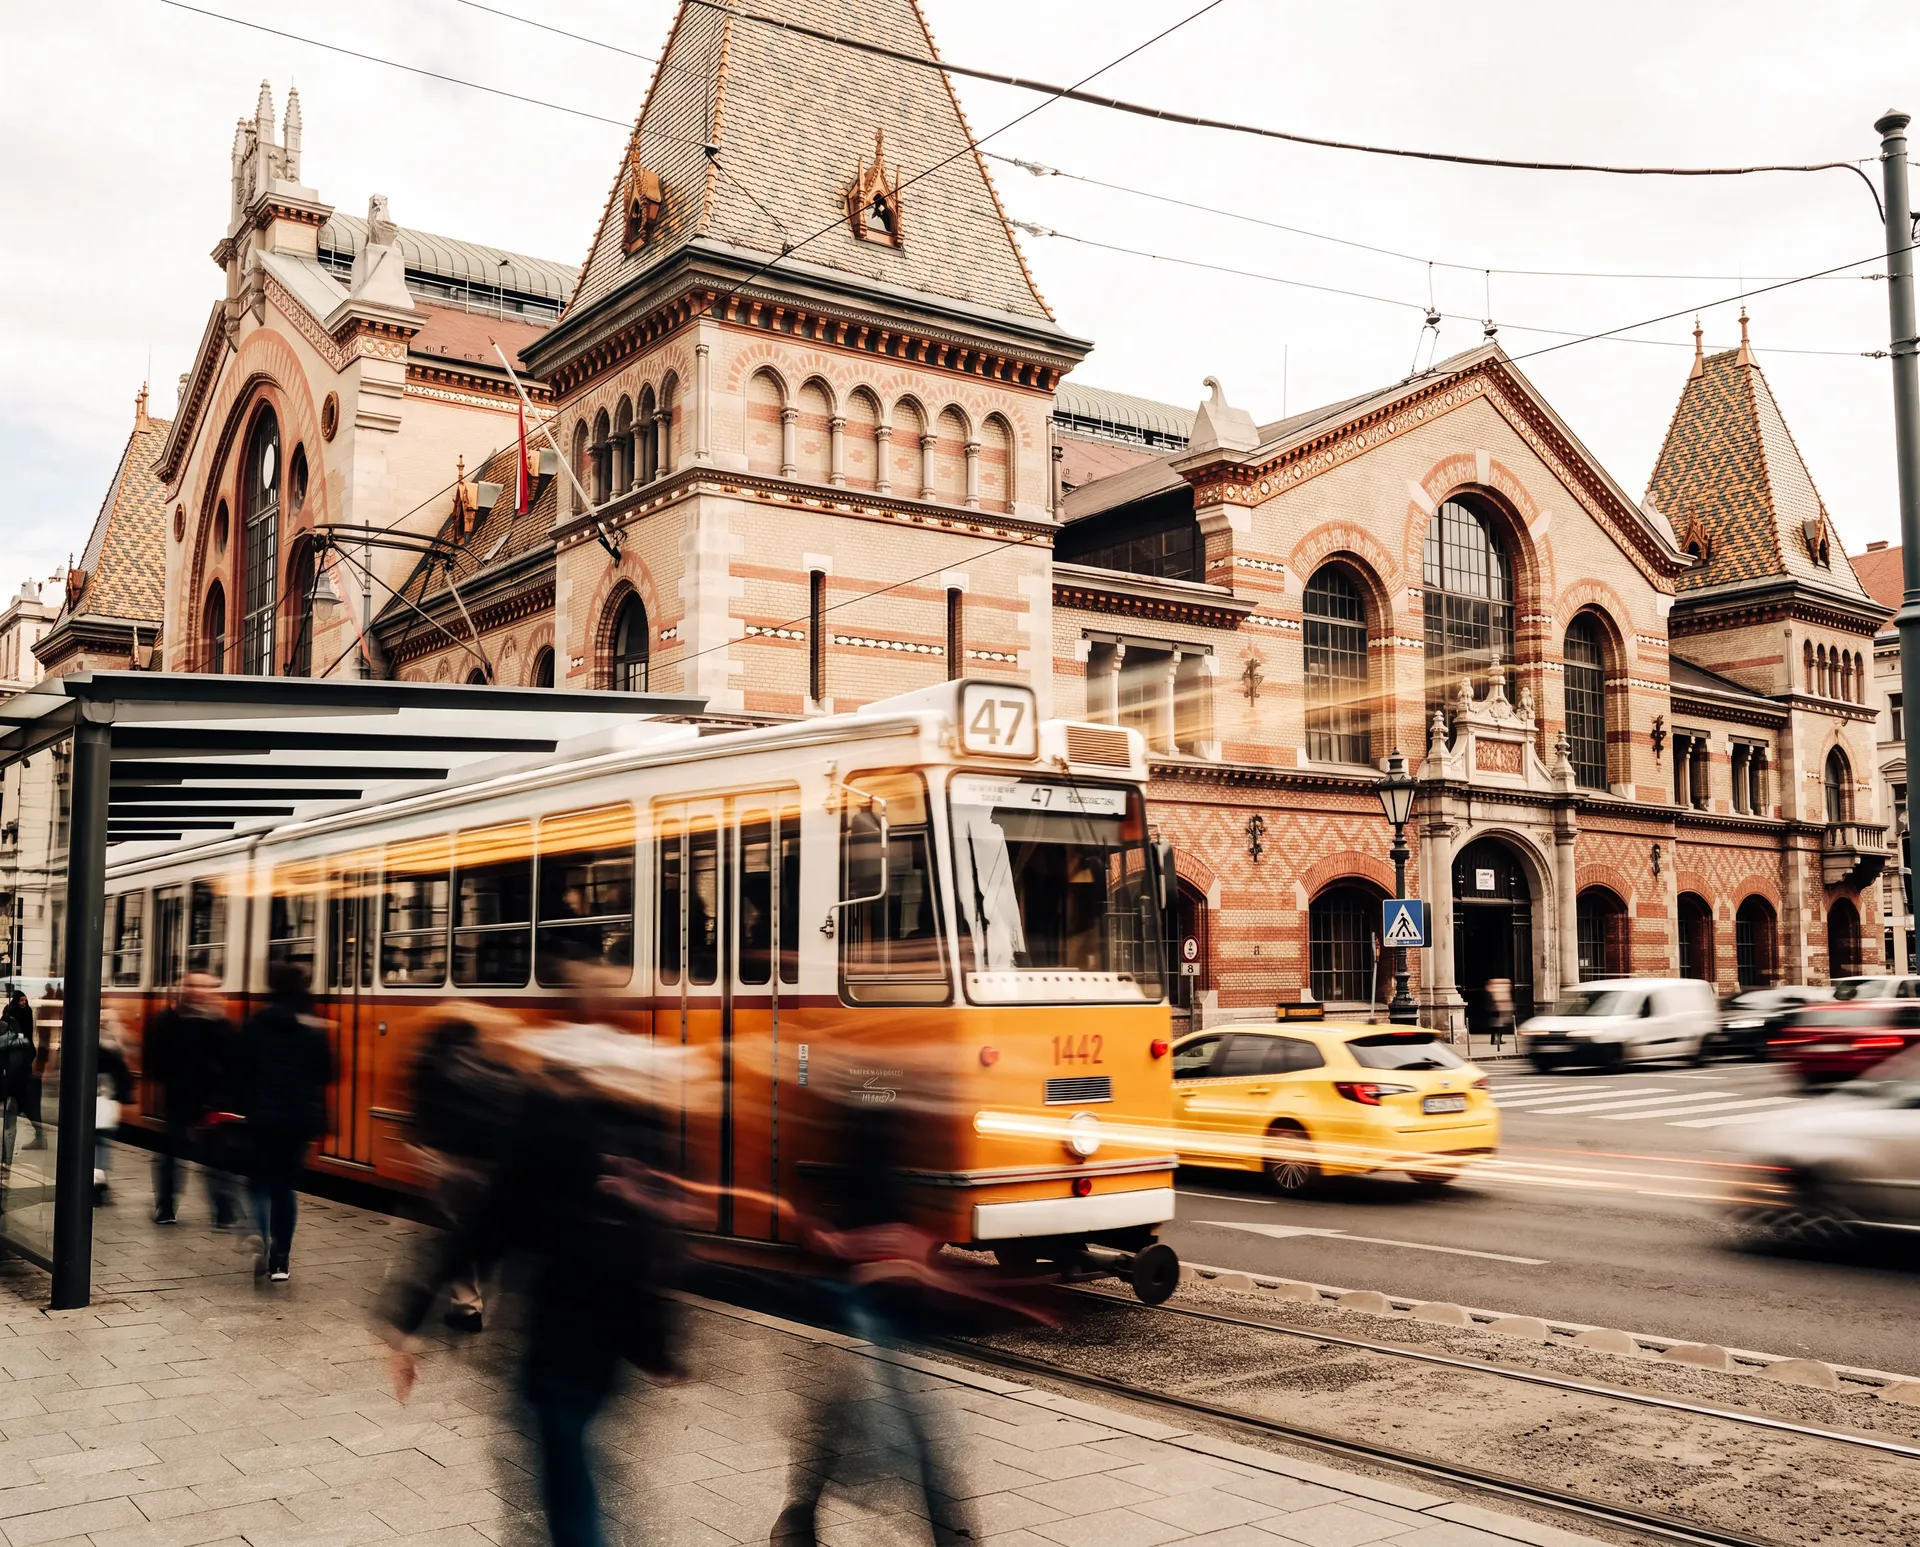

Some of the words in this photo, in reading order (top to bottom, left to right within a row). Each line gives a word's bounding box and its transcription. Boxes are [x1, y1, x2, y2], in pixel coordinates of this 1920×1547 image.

[970, 699, 1025, 746] 47
[1031, 788, 1053, 808] 47
[1051, 1034, 1104, 1066] 1442
